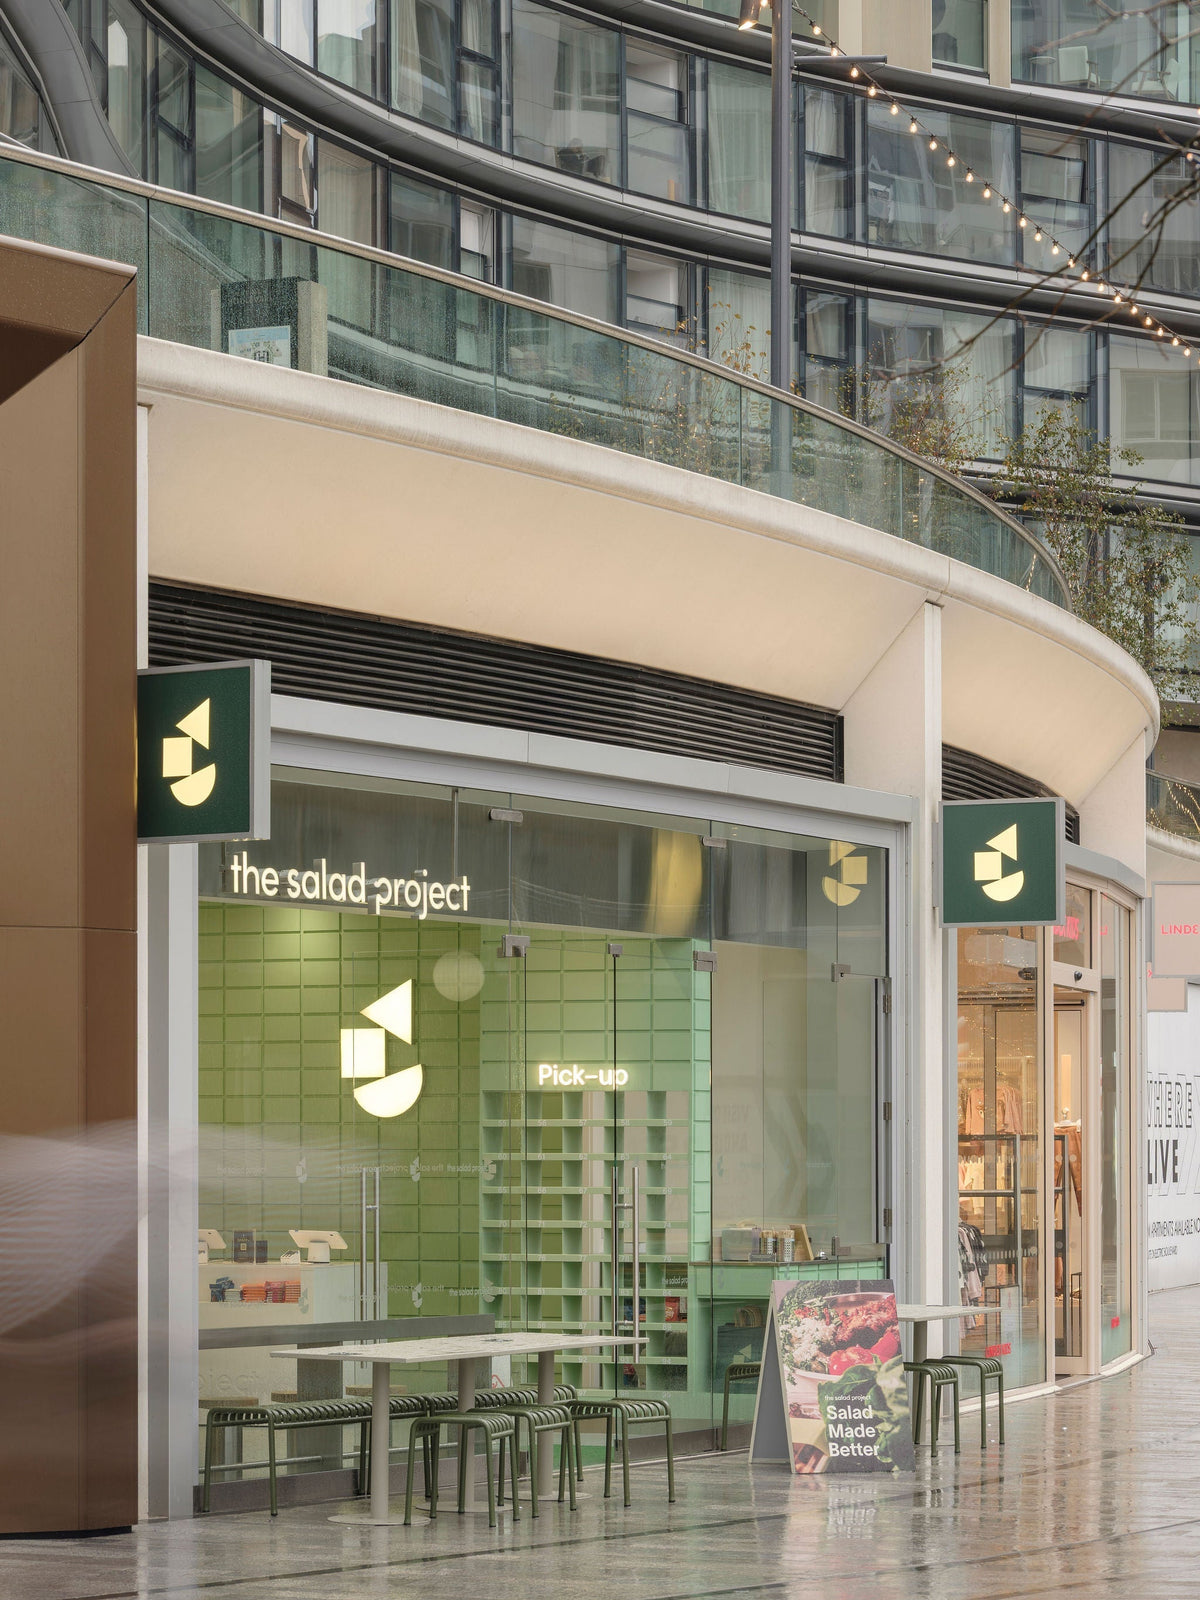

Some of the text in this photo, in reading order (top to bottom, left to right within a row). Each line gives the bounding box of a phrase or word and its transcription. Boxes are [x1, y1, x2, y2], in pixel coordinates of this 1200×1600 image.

[230, 851, 470, 920] the salad project
[538, 1063, 629, 1090] Pick-up
[1147, 1139, 1178, 1184] LIVE
[851, 1394, 872, 1402] project
[826, 1404, 873, 1420] Salad
[828, 1423, 876, 1438] Made
[828, 1442, 880, 1457] Better
